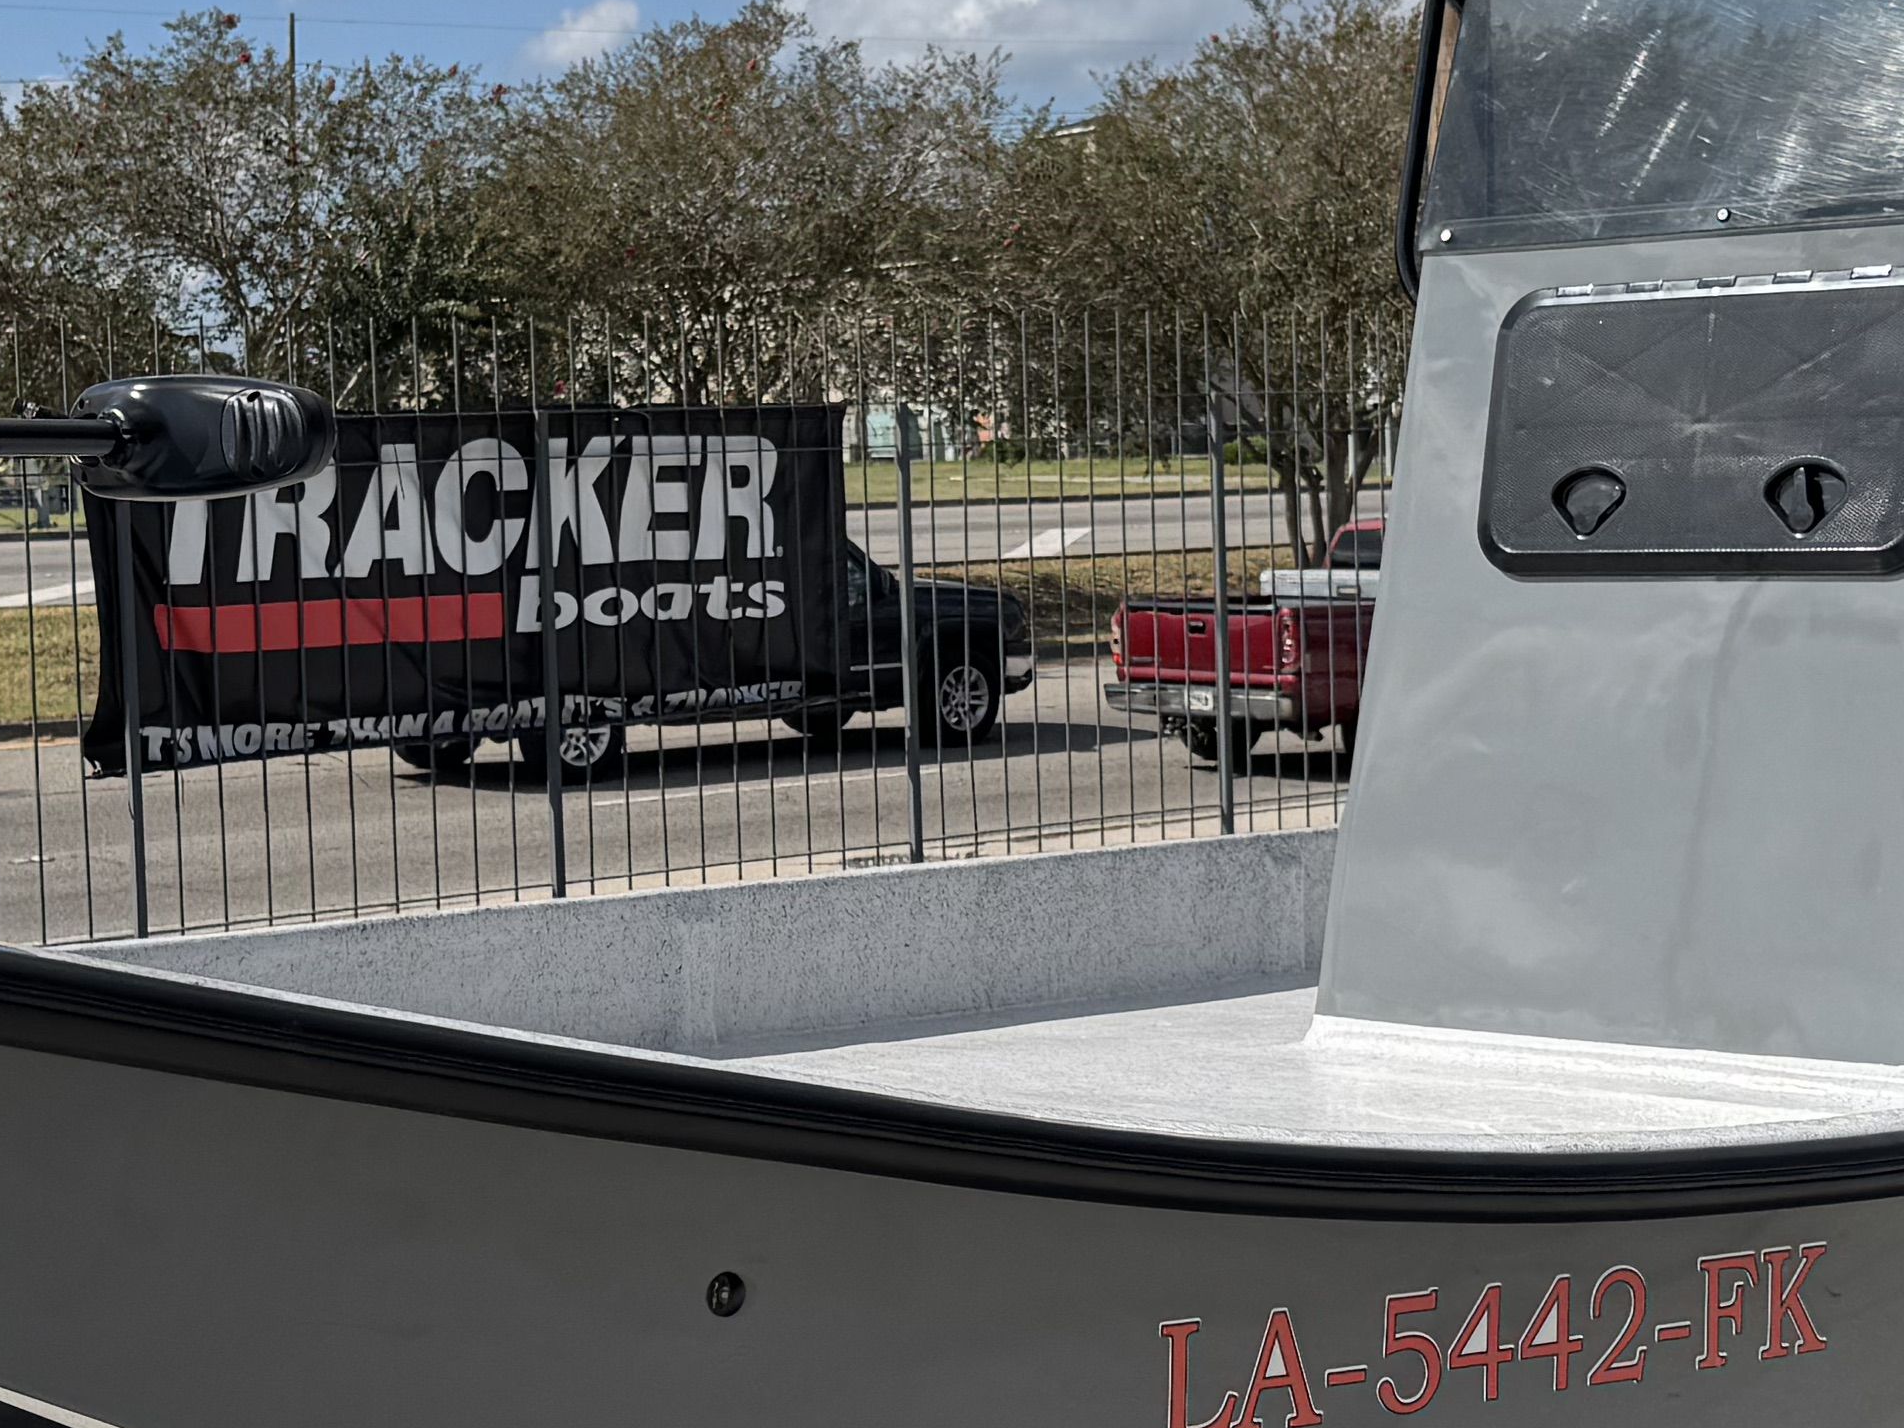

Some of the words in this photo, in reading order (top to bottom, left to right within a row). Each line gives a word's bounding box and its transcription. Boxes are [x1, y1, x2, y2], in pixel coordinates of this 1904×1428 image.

[515, 574, 787, 634] boats
[139, 725, 193, 764] T'S
[196, 722, 323, 762] MORE
[328, 712, 428, 746] THAN
